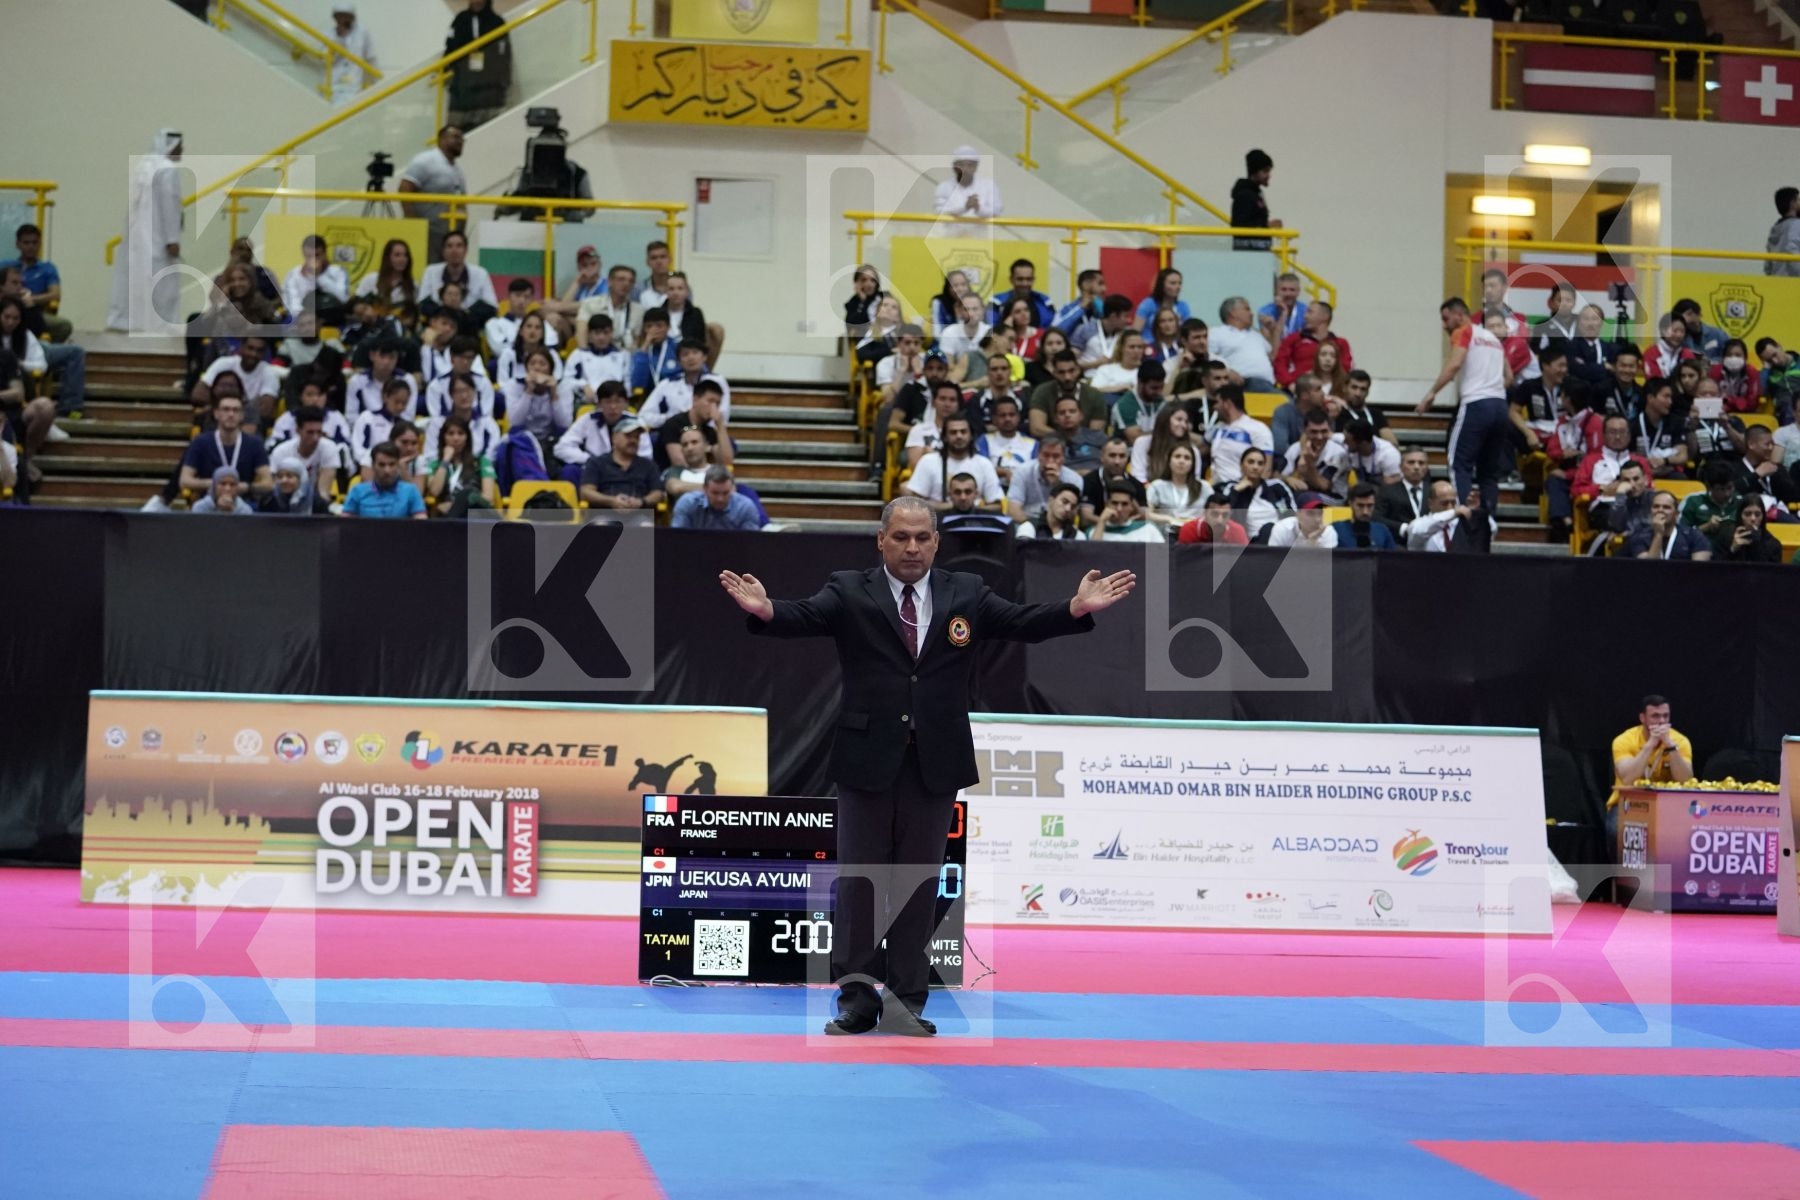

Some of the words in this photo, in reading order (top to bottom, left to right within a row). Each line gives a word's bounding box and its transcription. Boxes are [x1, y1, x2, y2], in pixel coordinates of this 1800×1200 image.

[450, 755, 527, 766] PREMIER
[533, 758, 600, 767] LEAGUE
[319, 782, 333, 795] Al
[337, 783, 367, 796] Wasl
[371, 783, 400, 797] Club
[404, 785, 442, 797] 16-18
[445, 786, 503, 801] February
[507, 787, 540, 800] 2018
[1082, 779, 1173, 796] MOHAMMAD
[1178, 781, 1221, 797] OMAR
[1225, 782, 1251, 798] BIN
[1255, 783, 1313, 799] HAIDER
[1317, 785, 1384, 800] HOLDING
[1387, 787, 1438, 802] GROUP
[316, 796, 504, 849] OPEN
[646, 814, 675, 827] FRA
[680, 810, 780, 827] FLORENTIN
[785, 812, 834, 828] ANNE
[680, 829, 717, 839] FRANCE
[1690, 831, 1766, 853] OPEN
[512, 806, 533, 895] KARATE
[653, 848, 664, 856] C1
[815, 851, 826, 859] C2
[1029, 851, 1063, 861] Holiday
[1064, 851, 1079, 860] Inn
[1767, 834, 1777, 874] KARATE
[1151, 853, 1179, 863] Haider
[1183, 853, 1231, 864] Hospitality
[1479, 858, 1509, 866] Tourism
[1689, 853, 1765, 875] DUBAI
[315, 848, 503, 897] DUBAI
[680, 870, 752, 887] UEKUSA
[755, 872, 811, 888] AYUMI
[645, 875, 673, 887] JPN
[678, 889, 708, 899] JAPAN
[652, 908, 663, 917] C1
[813, 912, 825, 920] C2
[1168, 904, 1184, 912] JW
[644, 933, 690, 946] TATAMI
[771, 920, 833, 954] 2:00
[664, 950, 671, 960] 1
[944, 955, 962, 966] KG
